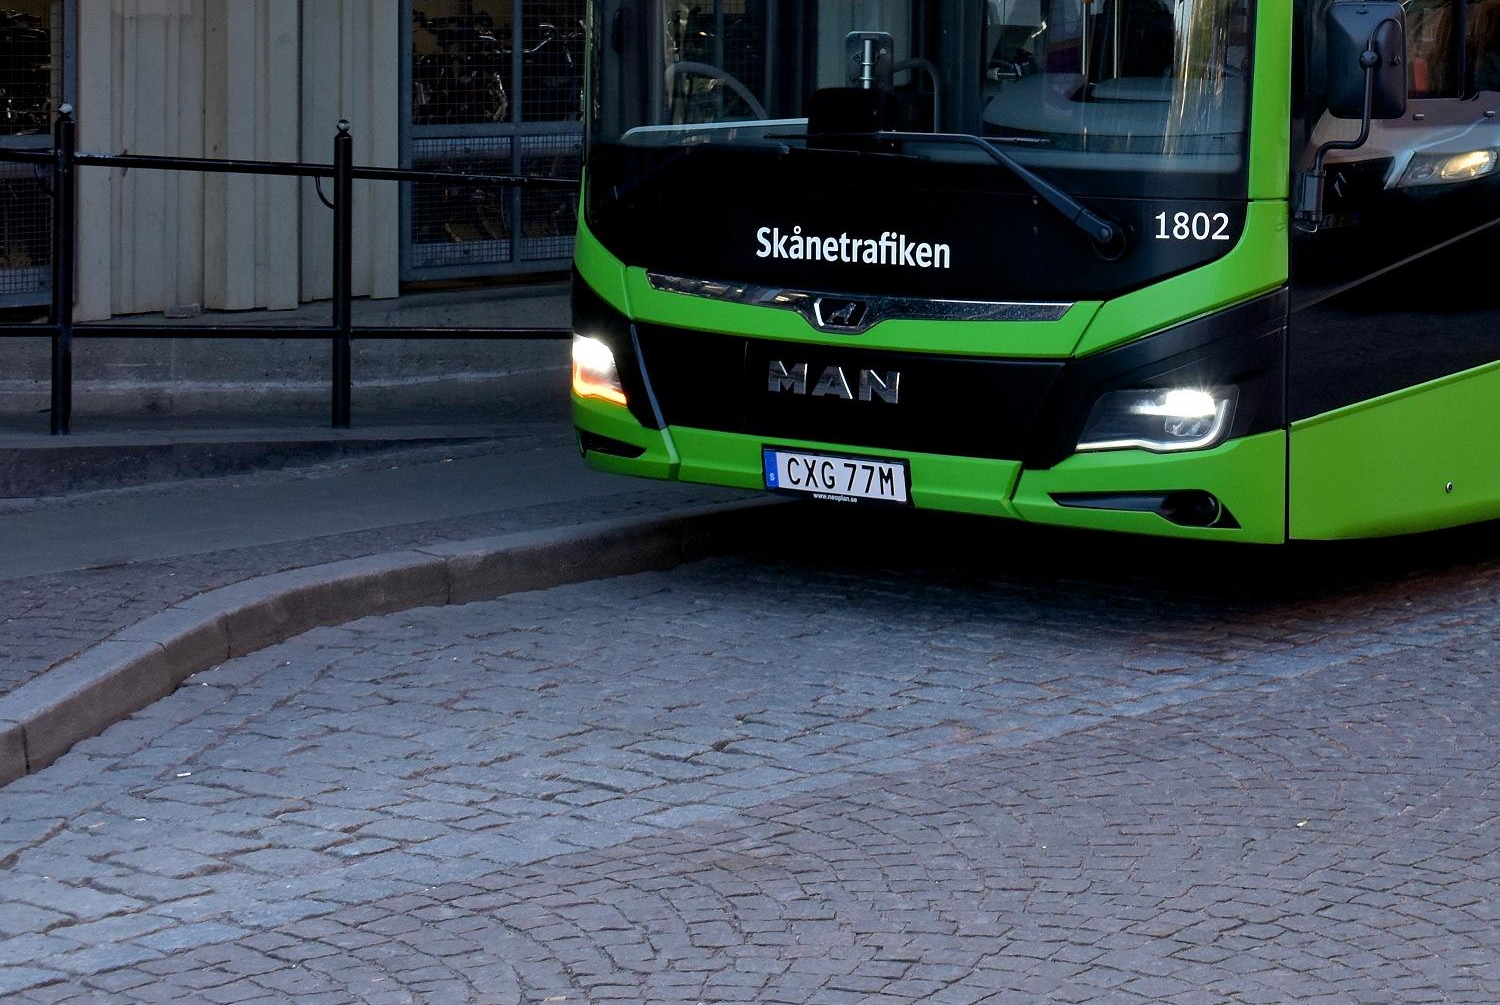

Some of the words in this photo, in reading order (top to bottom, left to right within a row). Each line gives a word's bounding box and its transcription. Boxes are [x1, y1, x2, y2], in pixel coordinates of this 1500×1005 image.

[1155, 211, 1230, 240] 1802
[756, 225, 950, 269] Skånetrafiken
[768, 360, 900, 404] MAN
[787, 457, 835, 490] CXG
[843, 462, 895, 496] 77M
